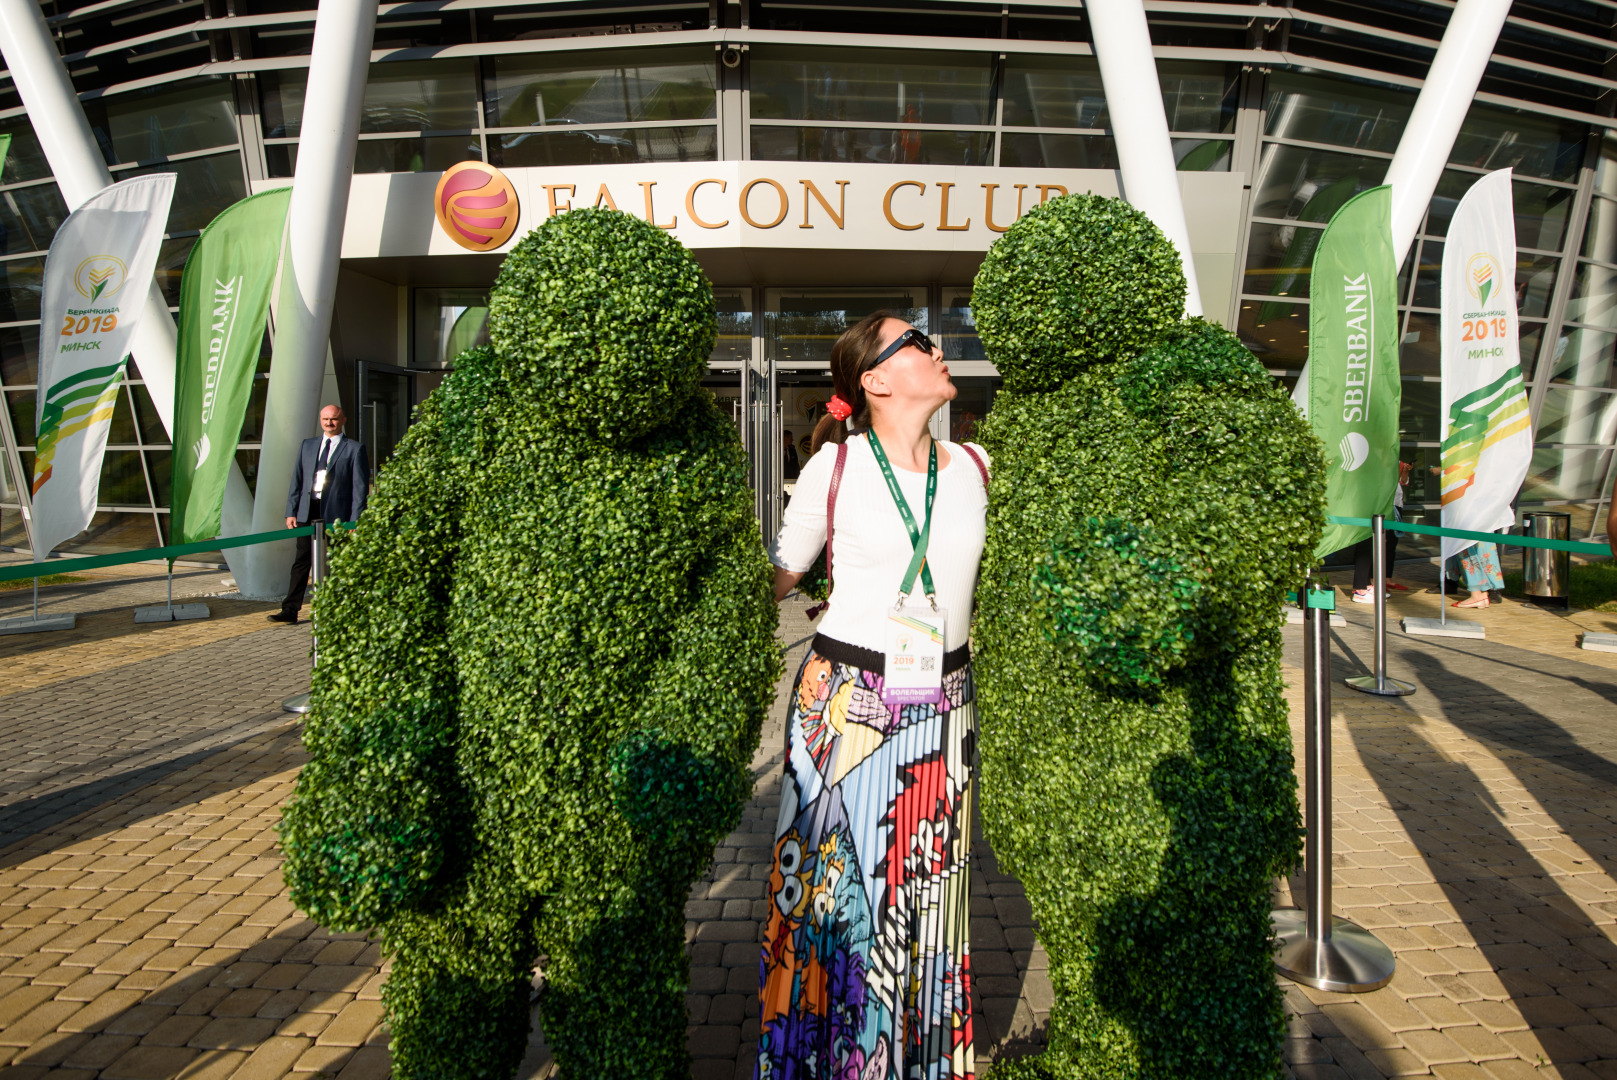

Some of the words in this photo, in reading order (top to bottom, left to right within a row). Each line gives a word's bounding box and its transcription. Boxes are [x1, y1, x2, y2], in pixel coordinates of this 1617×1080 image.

[541, 177, 850, 230] FALCON
[61, 314, 117, 336] 2019
[1462, 318, 1506, 342] 2019
[60, 340, 101, 353] МИНСК
[1344, 273, 1367, 421] SBERBANK
[1468, 347, 1504, 359] МИНСК
